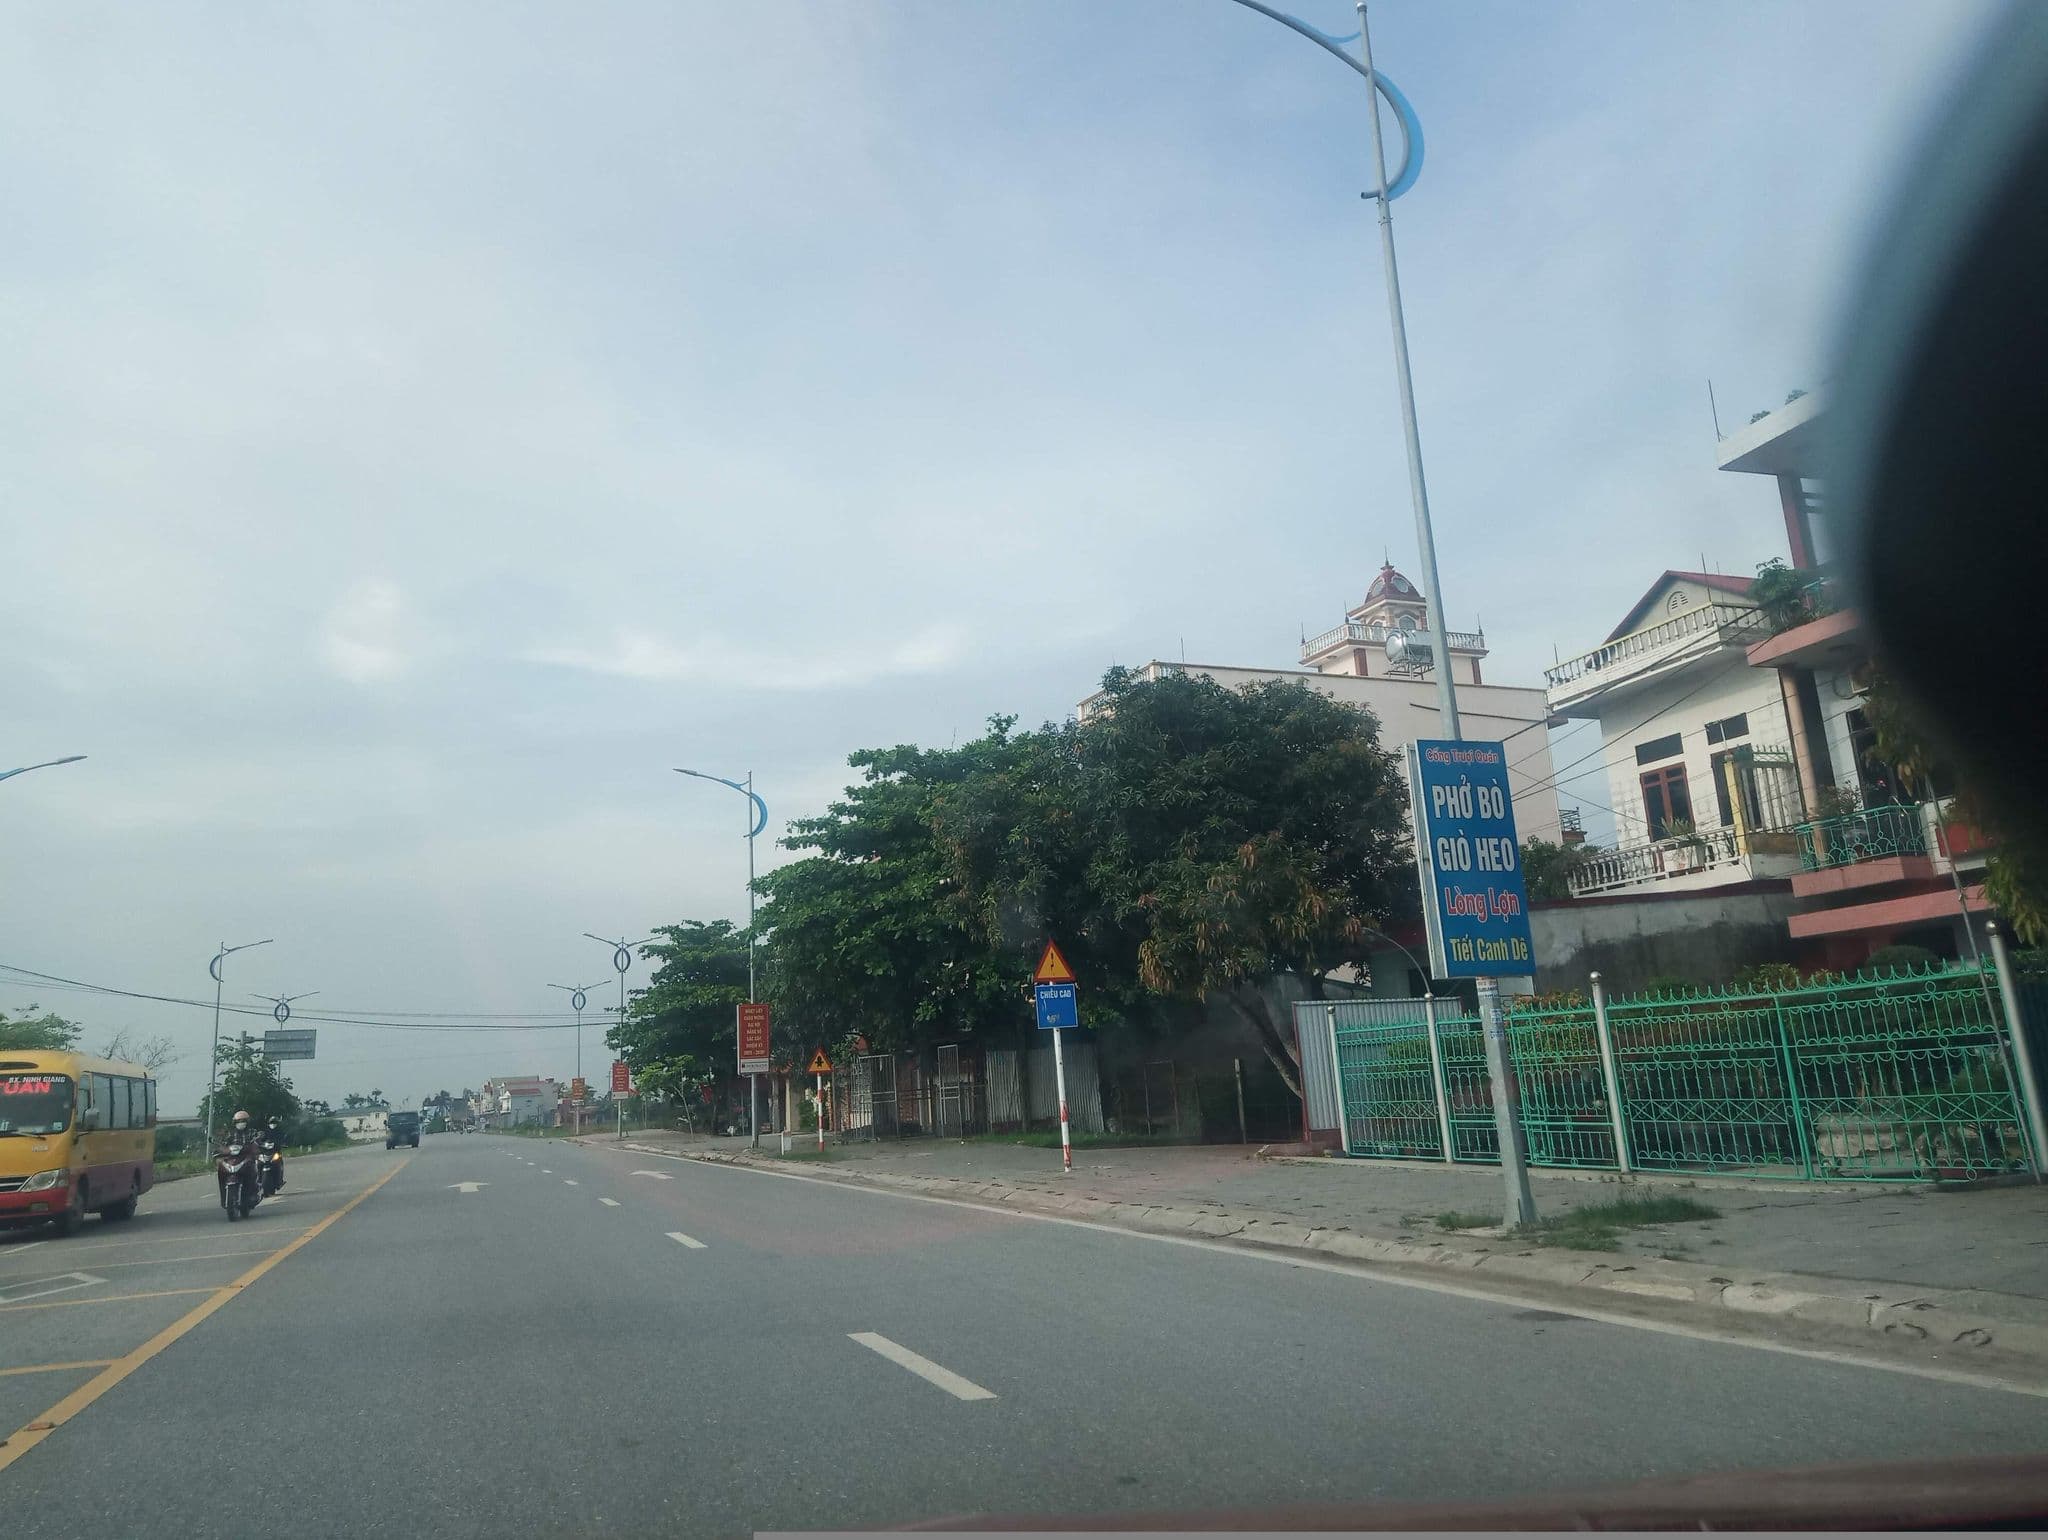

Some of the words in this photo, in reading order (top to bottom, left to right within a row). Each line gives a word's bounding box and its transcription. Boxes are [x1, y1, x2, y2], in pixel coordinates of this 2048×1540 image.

[1432, 774, 1473, 819] PHỞ
[1477, 779, 1505, 820] BÒ
[1437, 829, 1472, 872] GIÒ
[1475, 837, 1515, 872] HEO
[1444, 886, 1488, 923] Lòng
[1487, 887, 1521, 923] Lợn
[1449, 934, 1475, 961] Tiết
[1477, 938, 1509, 961] Canh
[1510, 937, 1528, 961] Dê
